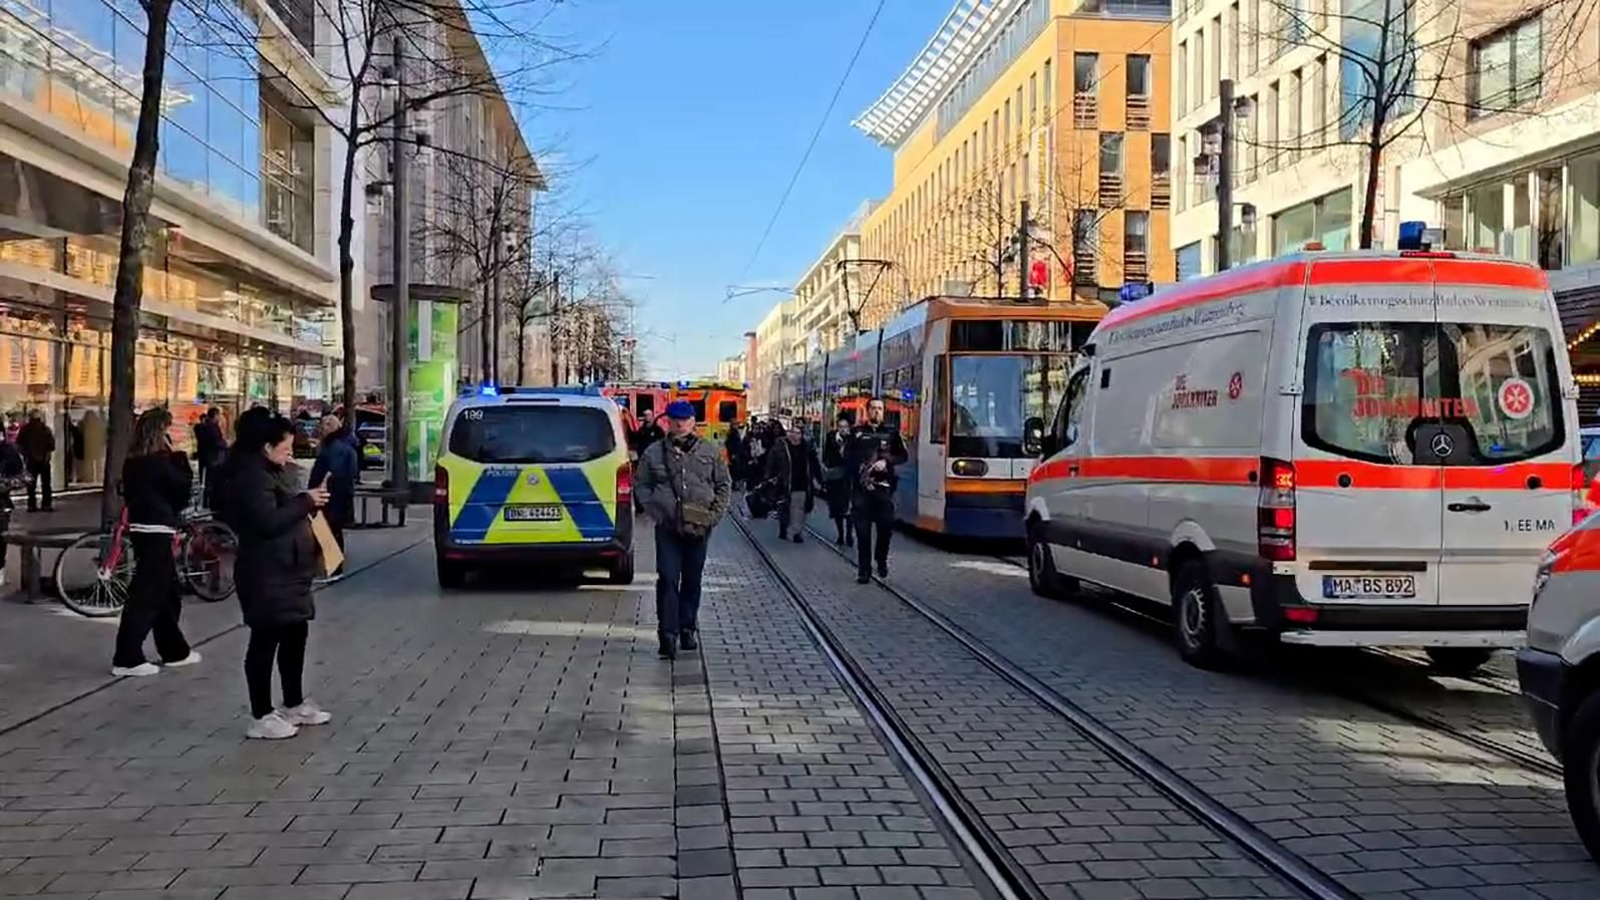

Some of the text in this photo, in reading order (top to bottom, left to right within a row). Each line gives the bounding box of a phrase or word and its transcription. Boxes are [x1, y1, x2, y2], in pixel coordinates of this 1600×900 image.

[1518, 519, 1532, 531] EE
[1535, 519, 1555, 531] MA
[1333, 579, 1413, 594] MA BS 892
